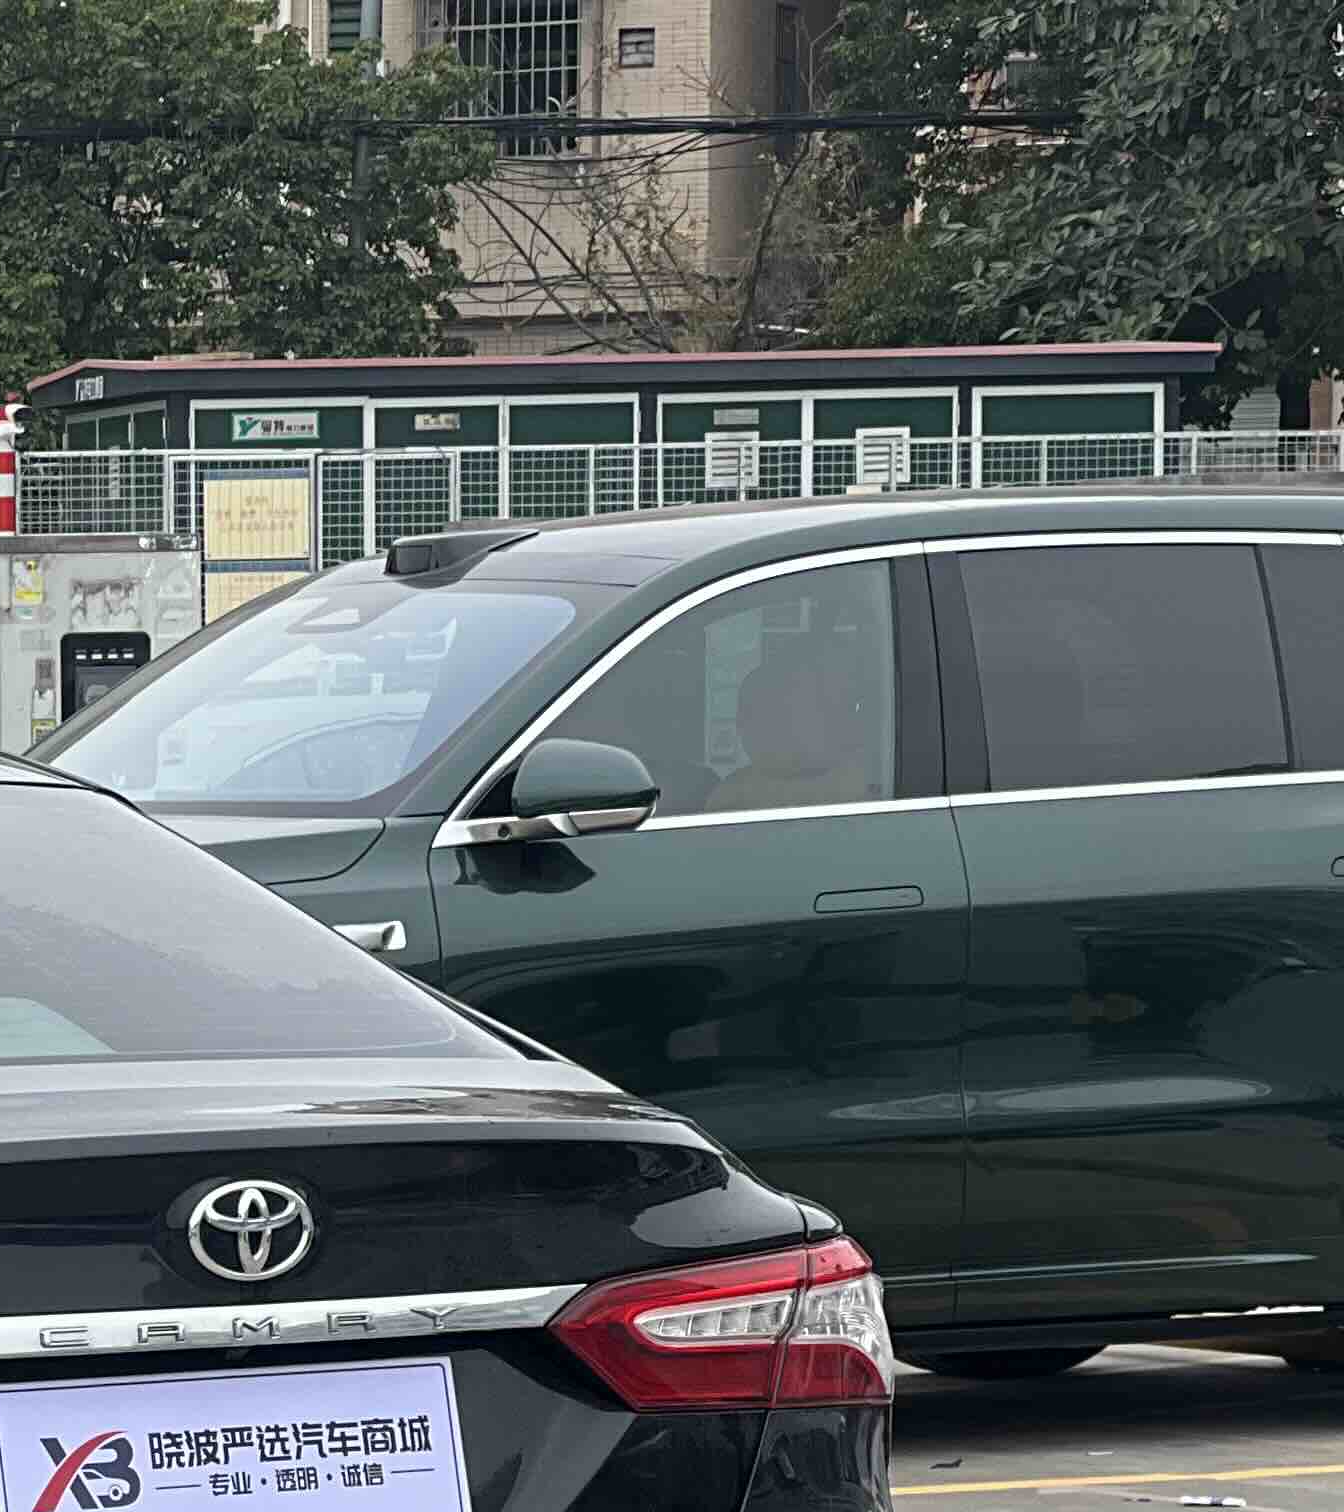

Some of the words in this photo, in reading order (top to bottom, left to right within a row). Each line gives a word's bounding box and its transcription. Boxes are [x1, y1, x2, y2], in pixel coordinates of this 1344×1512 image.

[39, 1305, 458, 1349] CAMRY
[148, 1415, 433, 1470] 晓波严选汽车商城
